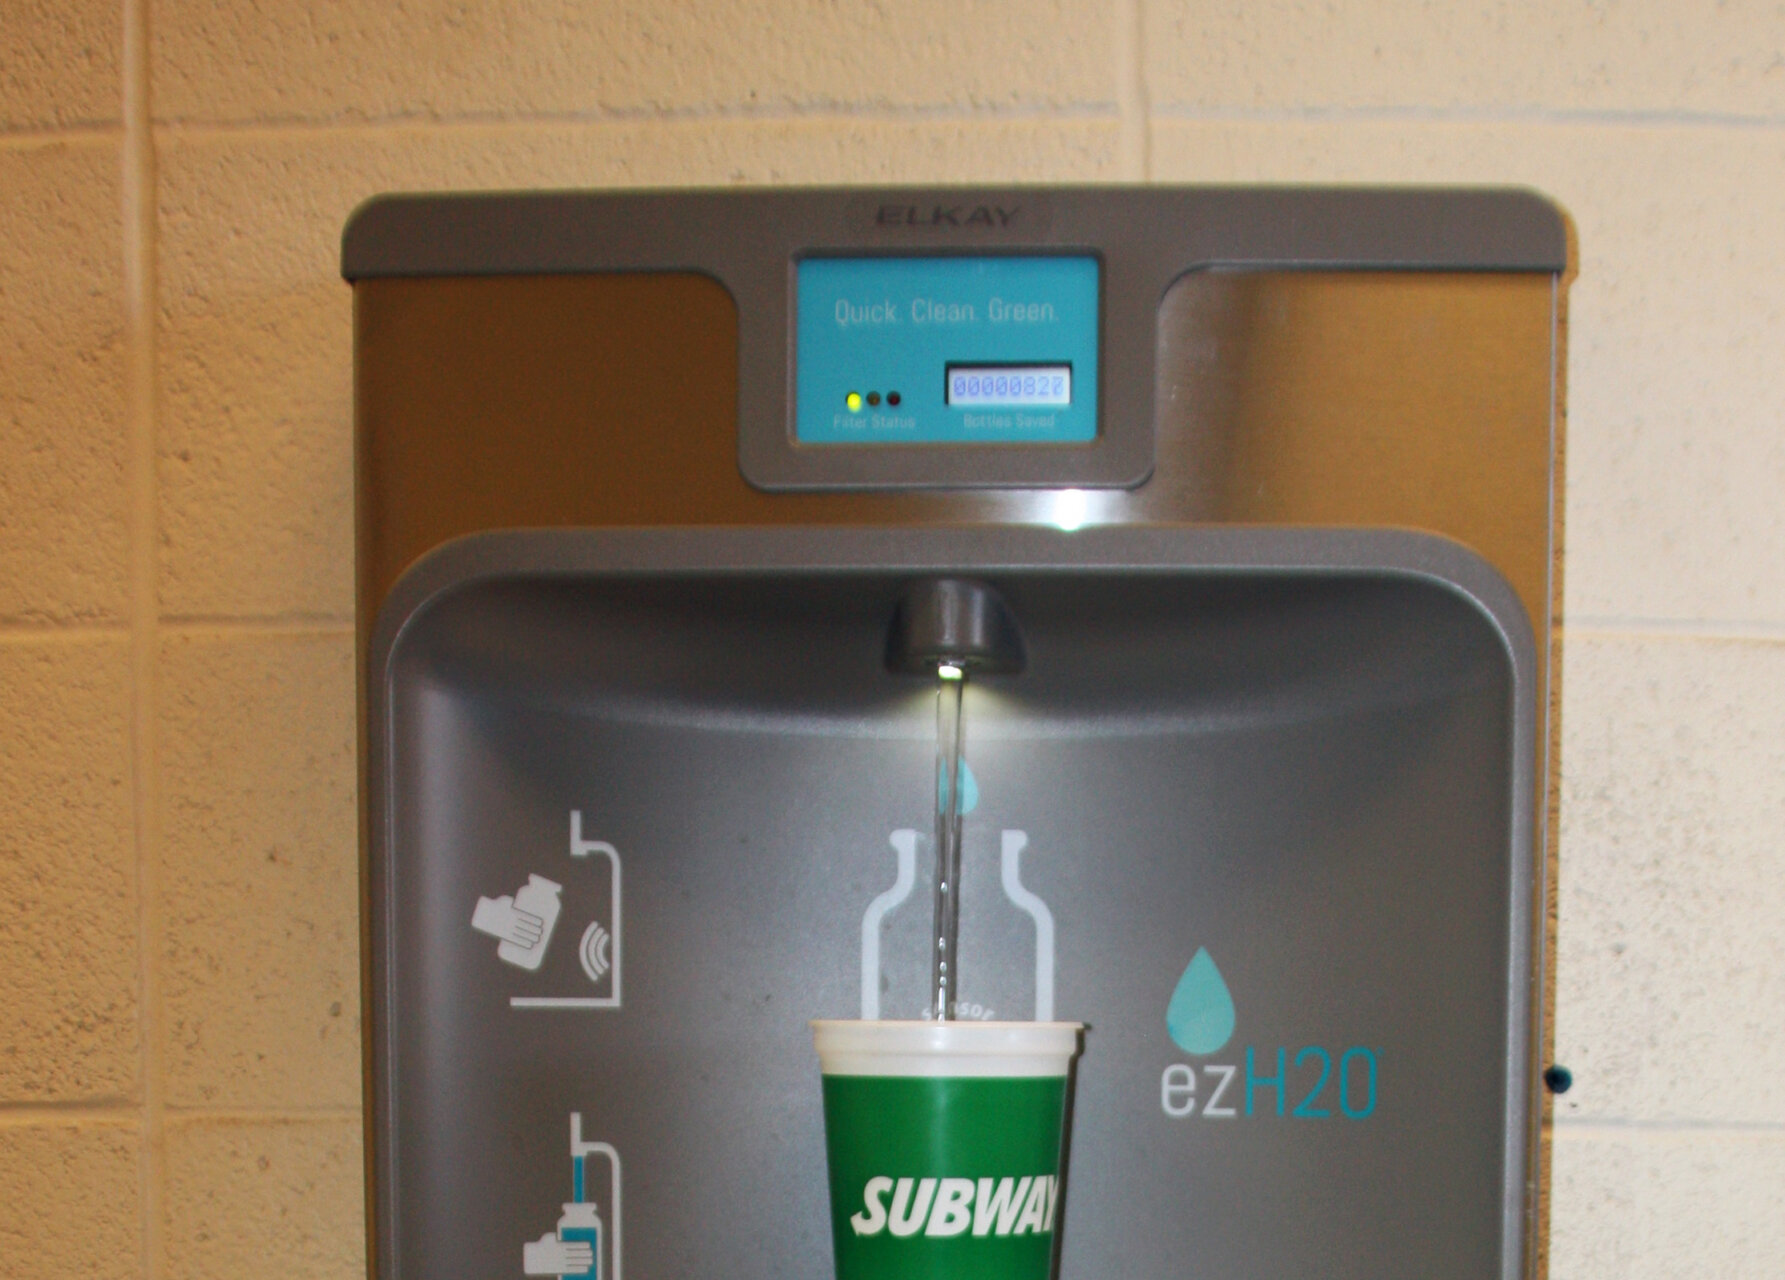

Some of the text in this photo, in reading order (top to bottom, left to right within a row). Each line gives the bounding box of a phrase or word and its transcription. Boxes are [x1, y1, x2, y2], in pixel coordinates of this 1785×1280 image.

[876, 205, 1022, 227] ELKAY
[871, 414, 916, 429] Status
[963, 413, 1055, 429] Bottles Saved
[850, 1174, 1058, 1238] SUBWAY
